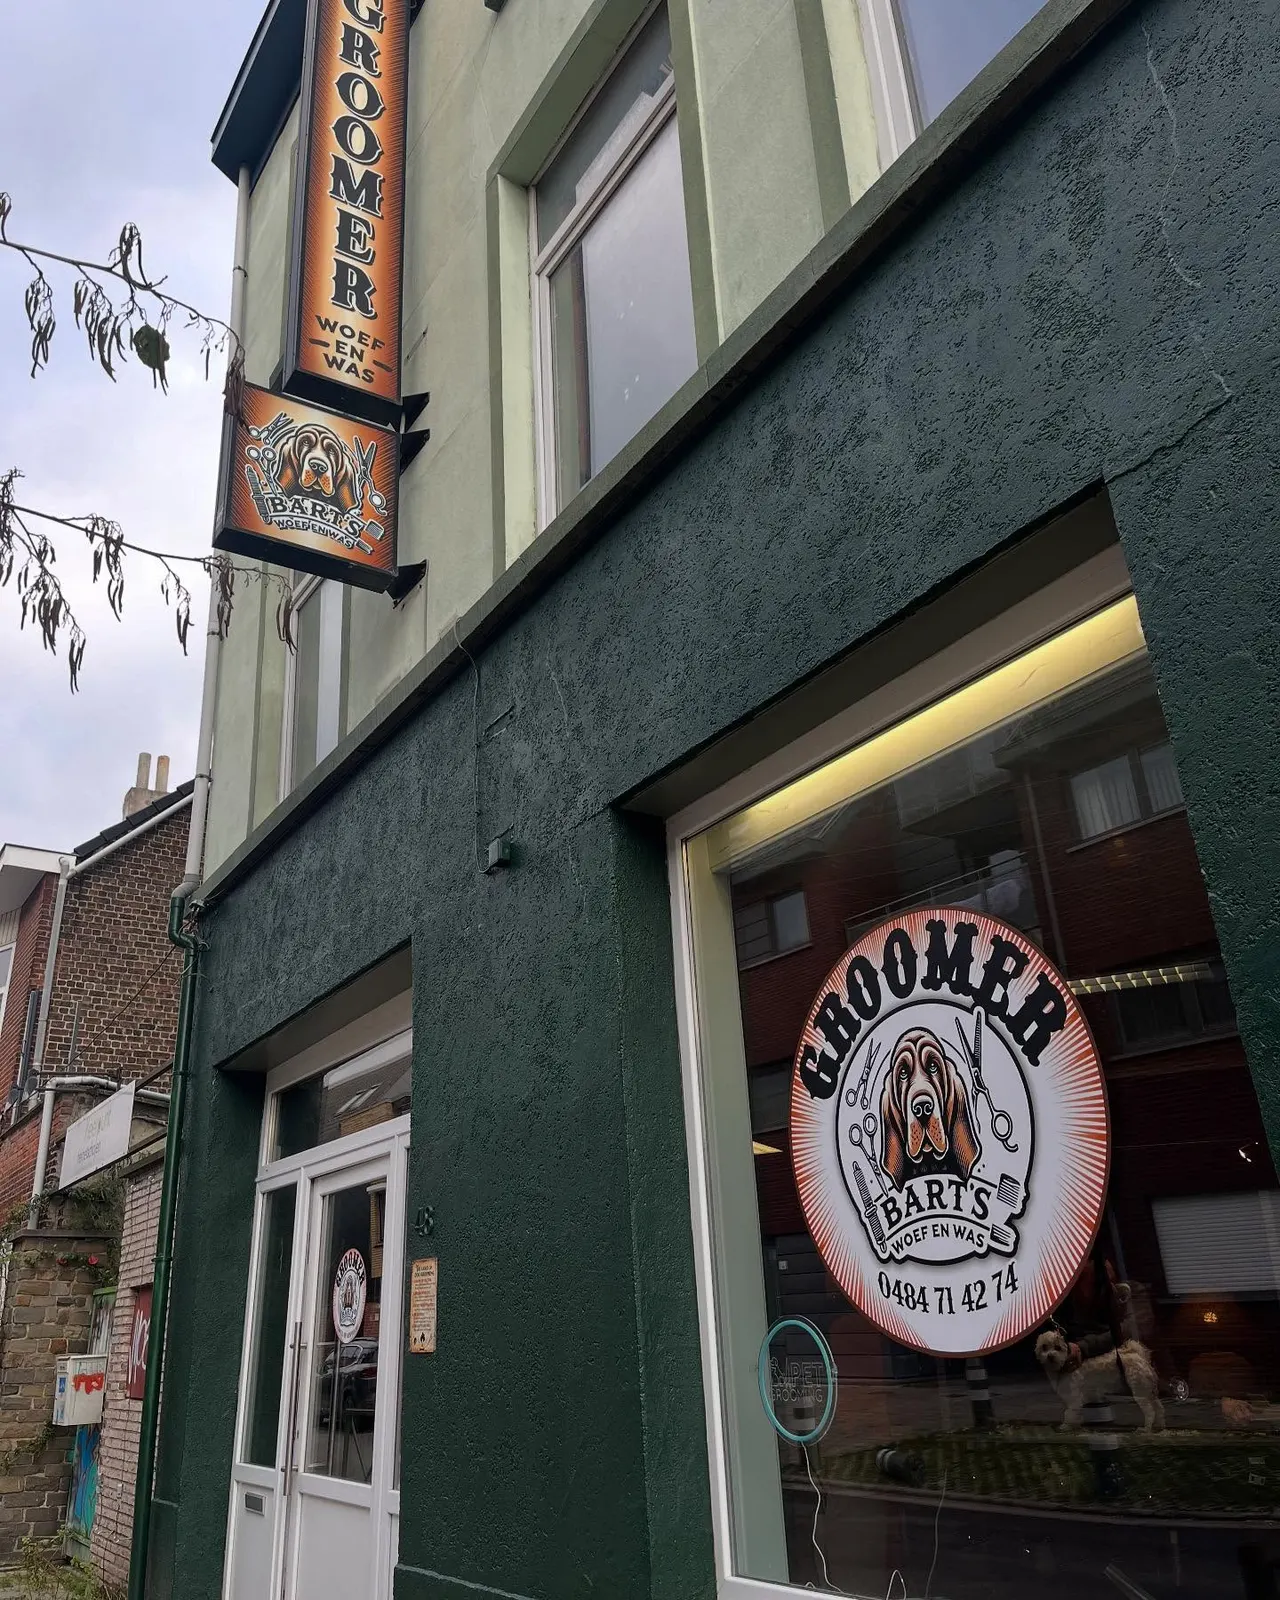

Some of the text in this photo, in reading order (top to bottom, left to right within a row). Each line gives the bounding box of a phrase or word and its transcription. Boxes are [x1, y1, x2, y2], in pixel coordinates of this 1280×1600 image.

[329, 0, 388, 321] GROOMER
[315, 315, 385, 350] WOEF
[323, 353, 375, 383] WAS
[335, 339, 364, 362] EN
[268, 496, 362, 537] BART'S
[275, 519, 353, 549] WOEF EN WAS
[800, 919, 1068, 1099] GROOMER
[880, 1179, 991, 1230] BART'S
[891, 1224, 985, 1254] WOEF EN WAS
[878, 1261, 1018, 1315] 0484 71 42 74
[790, 1361, 824, 1388] PET
